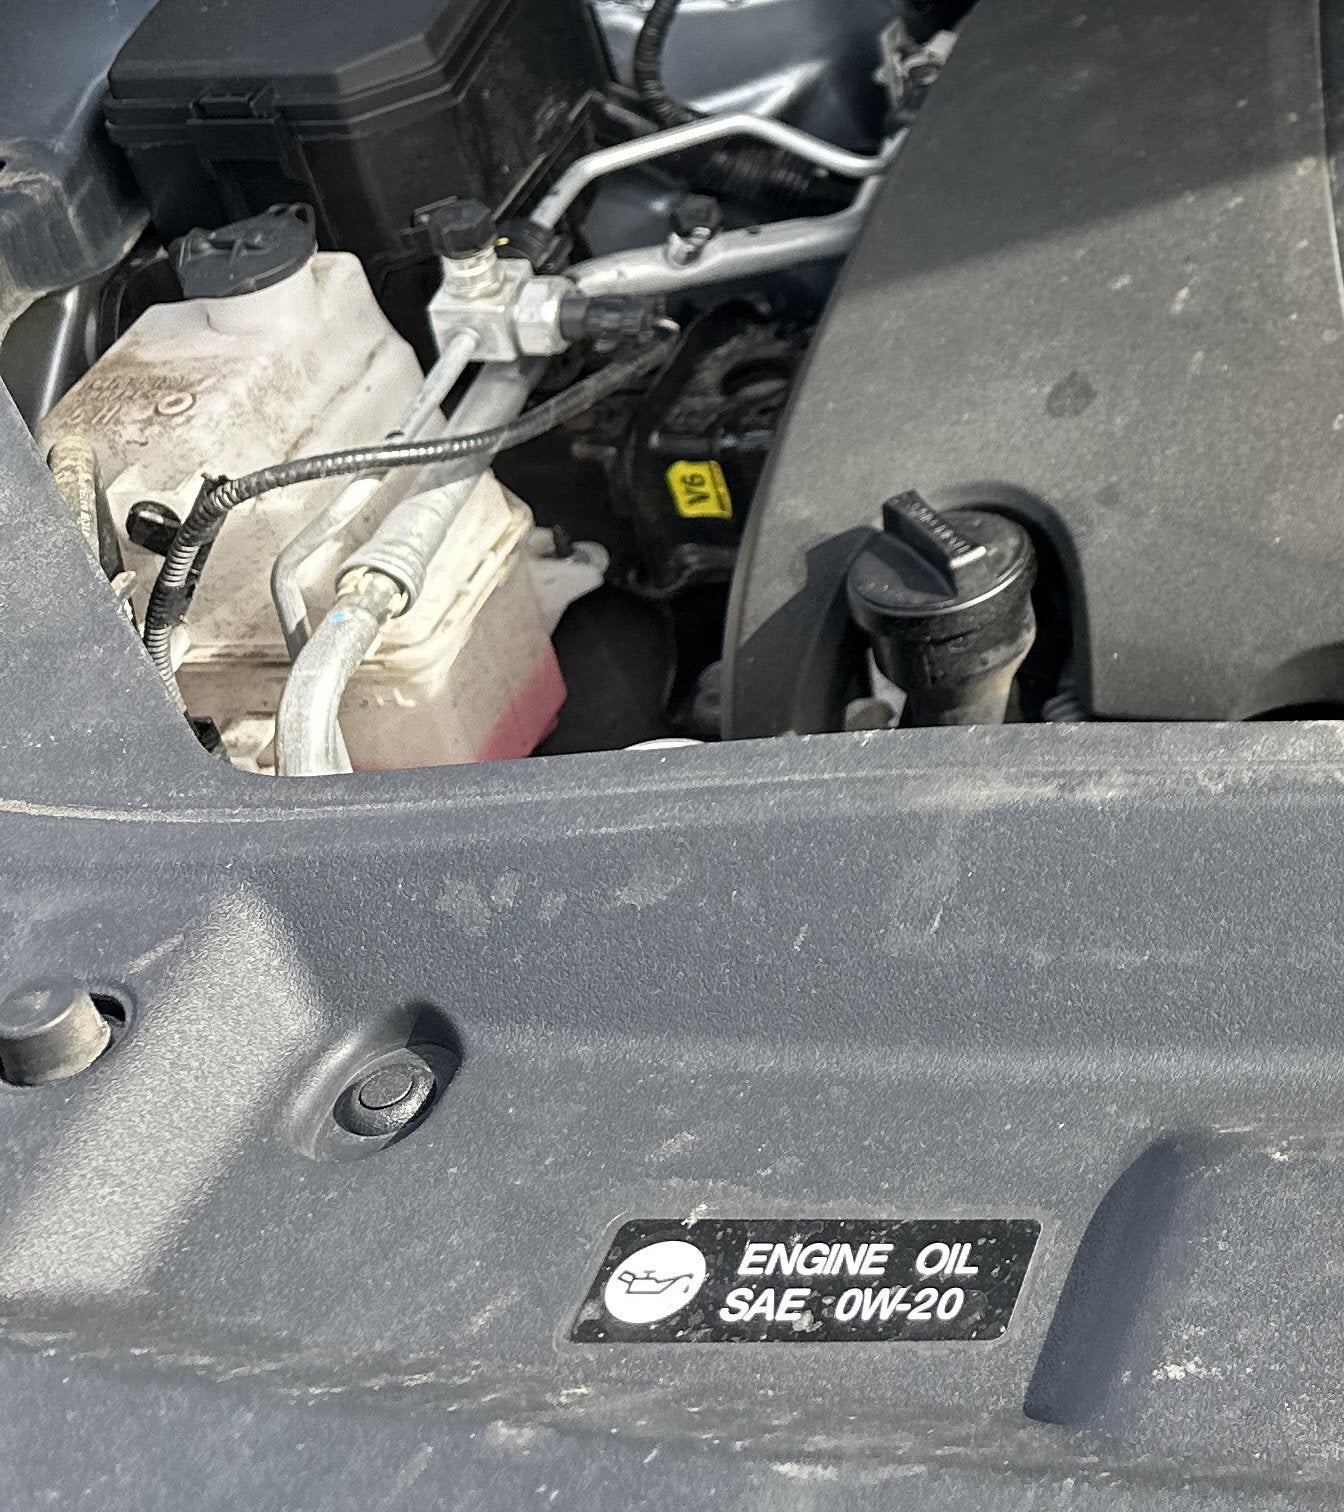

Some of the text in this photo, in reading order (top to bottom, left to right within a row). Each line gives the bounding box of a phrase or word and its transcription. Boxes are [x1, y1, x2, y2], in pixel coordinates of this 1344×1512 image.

[680, 473, 710, 506] V6
[737, 1242, 980, 1275] ENGINE OIL
[719, 1286, 964, 1323] SAE 0W-20
